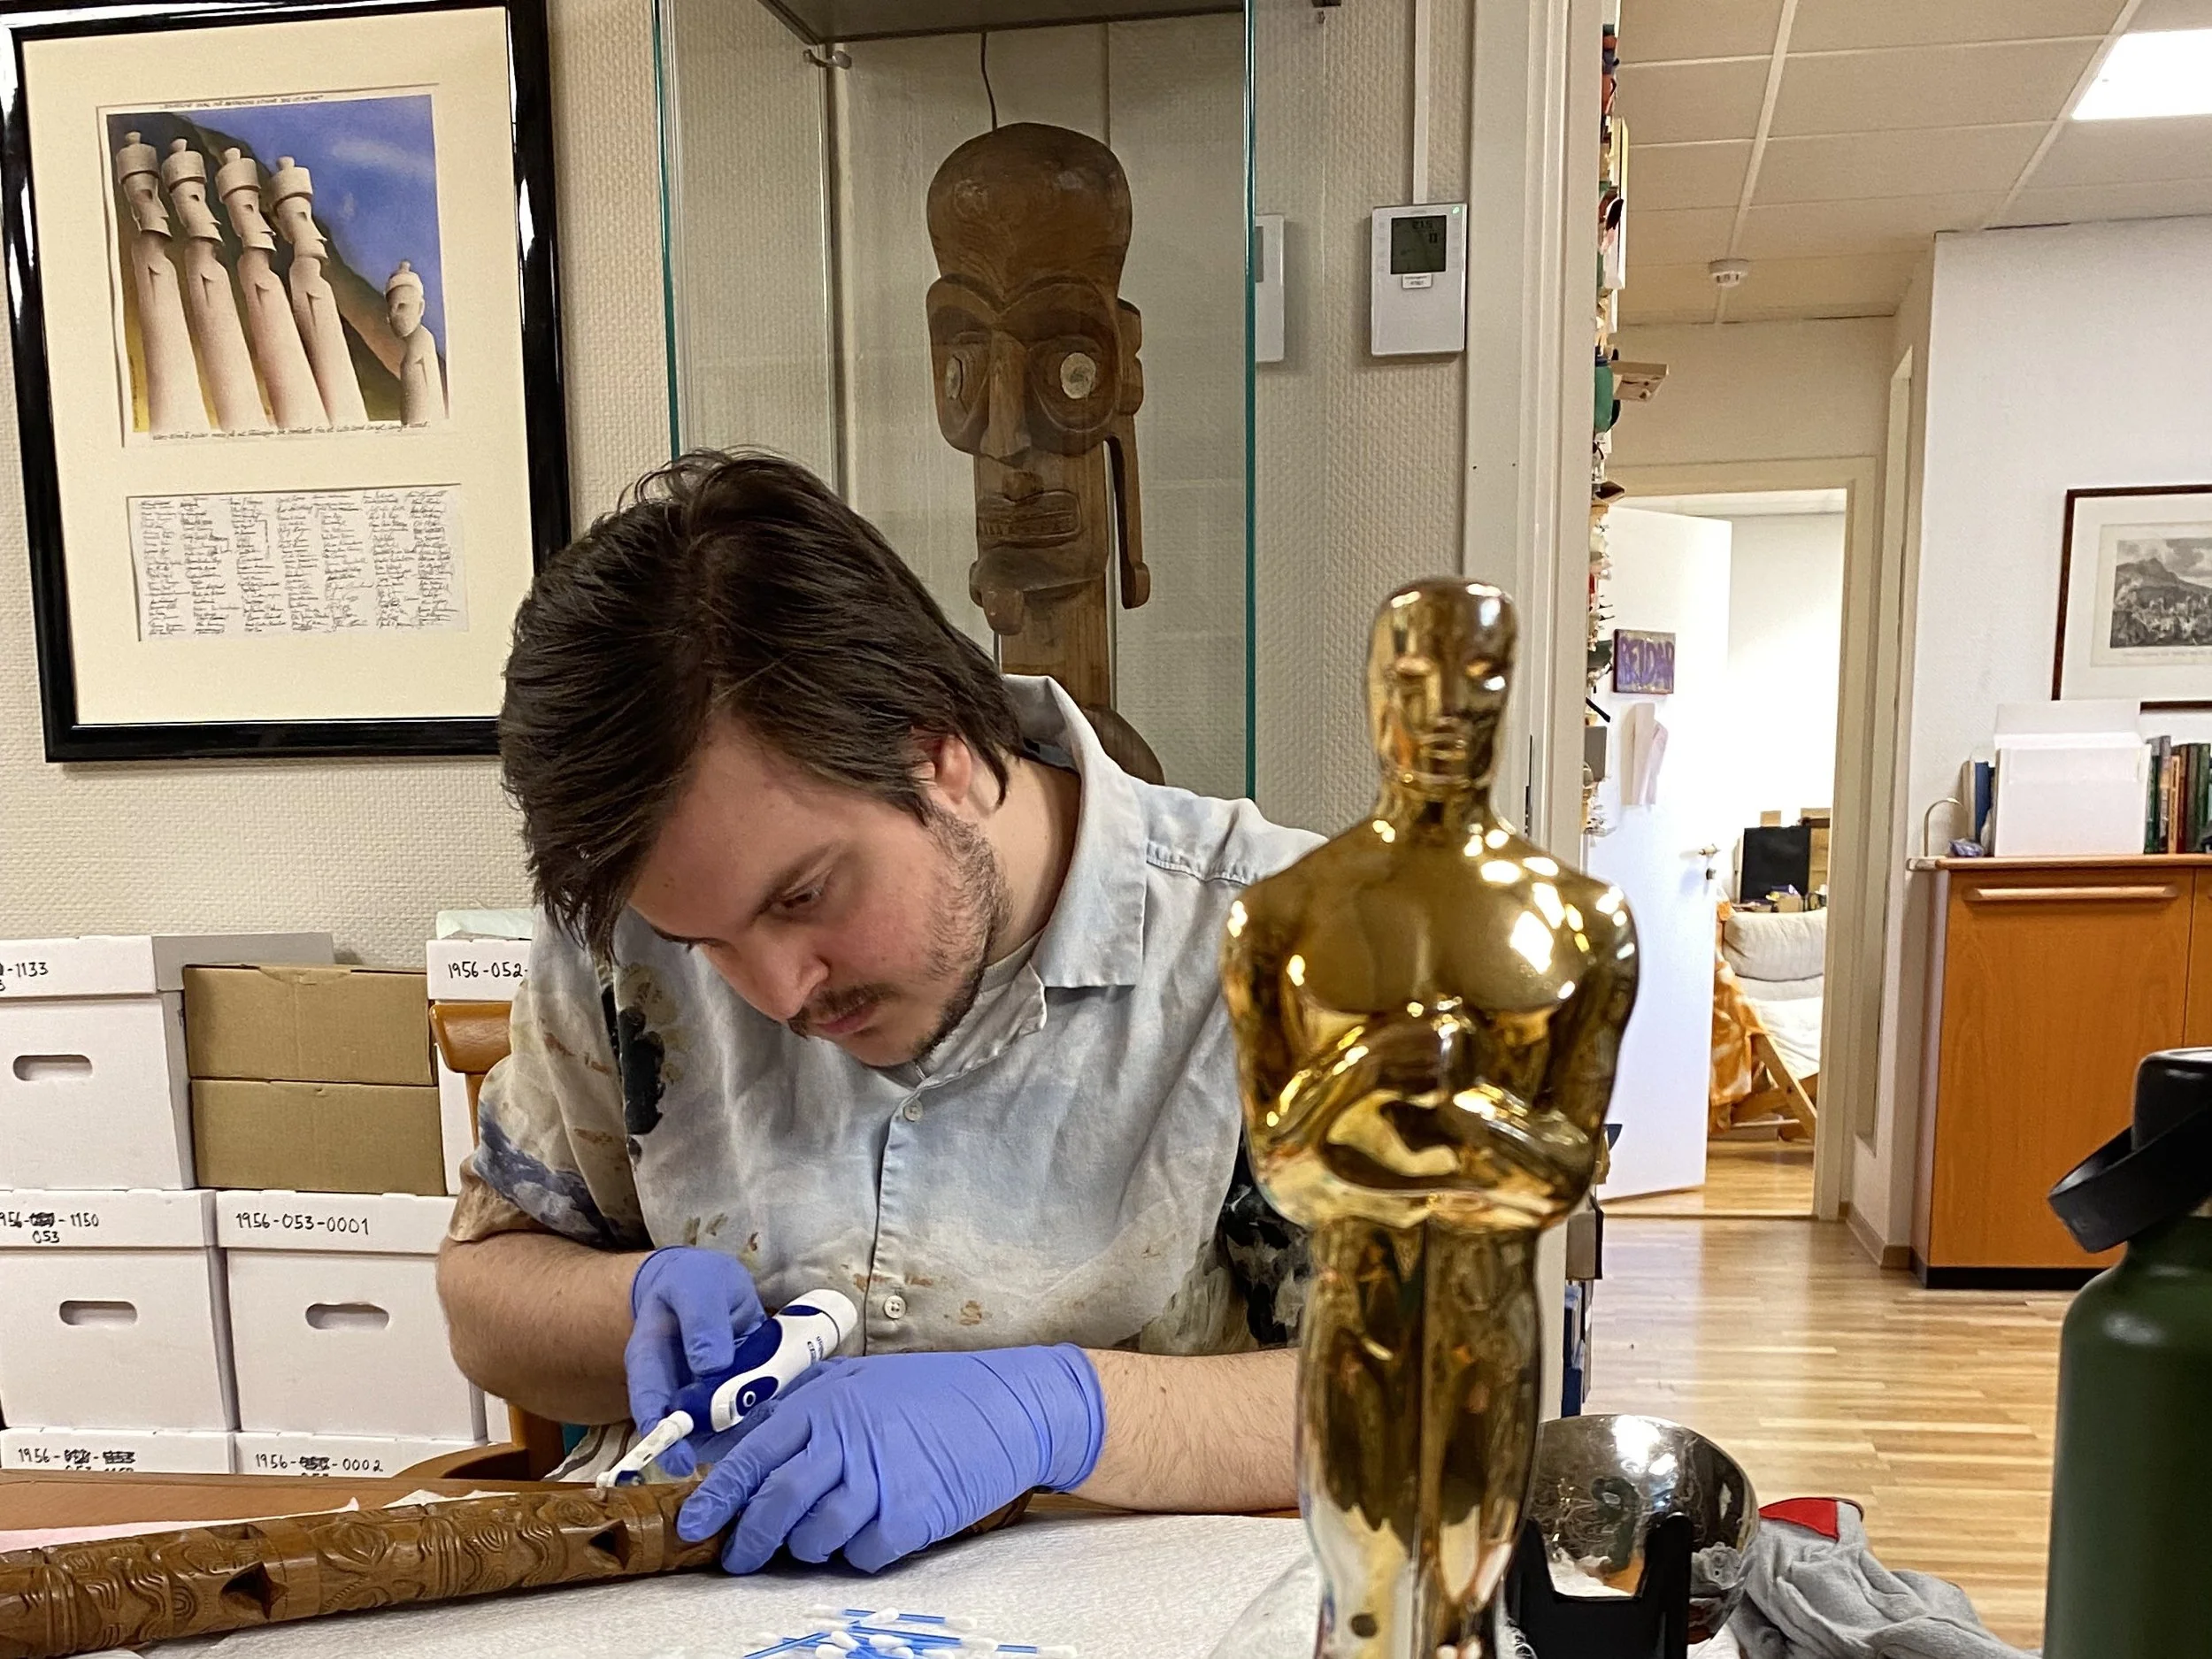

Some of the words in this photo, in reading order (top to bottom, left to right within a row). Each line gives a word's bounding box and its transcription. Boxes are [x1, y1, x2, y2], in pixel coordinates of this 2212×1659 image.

[0, 962, 49, 978] -1133
[236, 1212, 369, 1235] 1956-053-0001
[32, 1230, 60, 1244] 053
